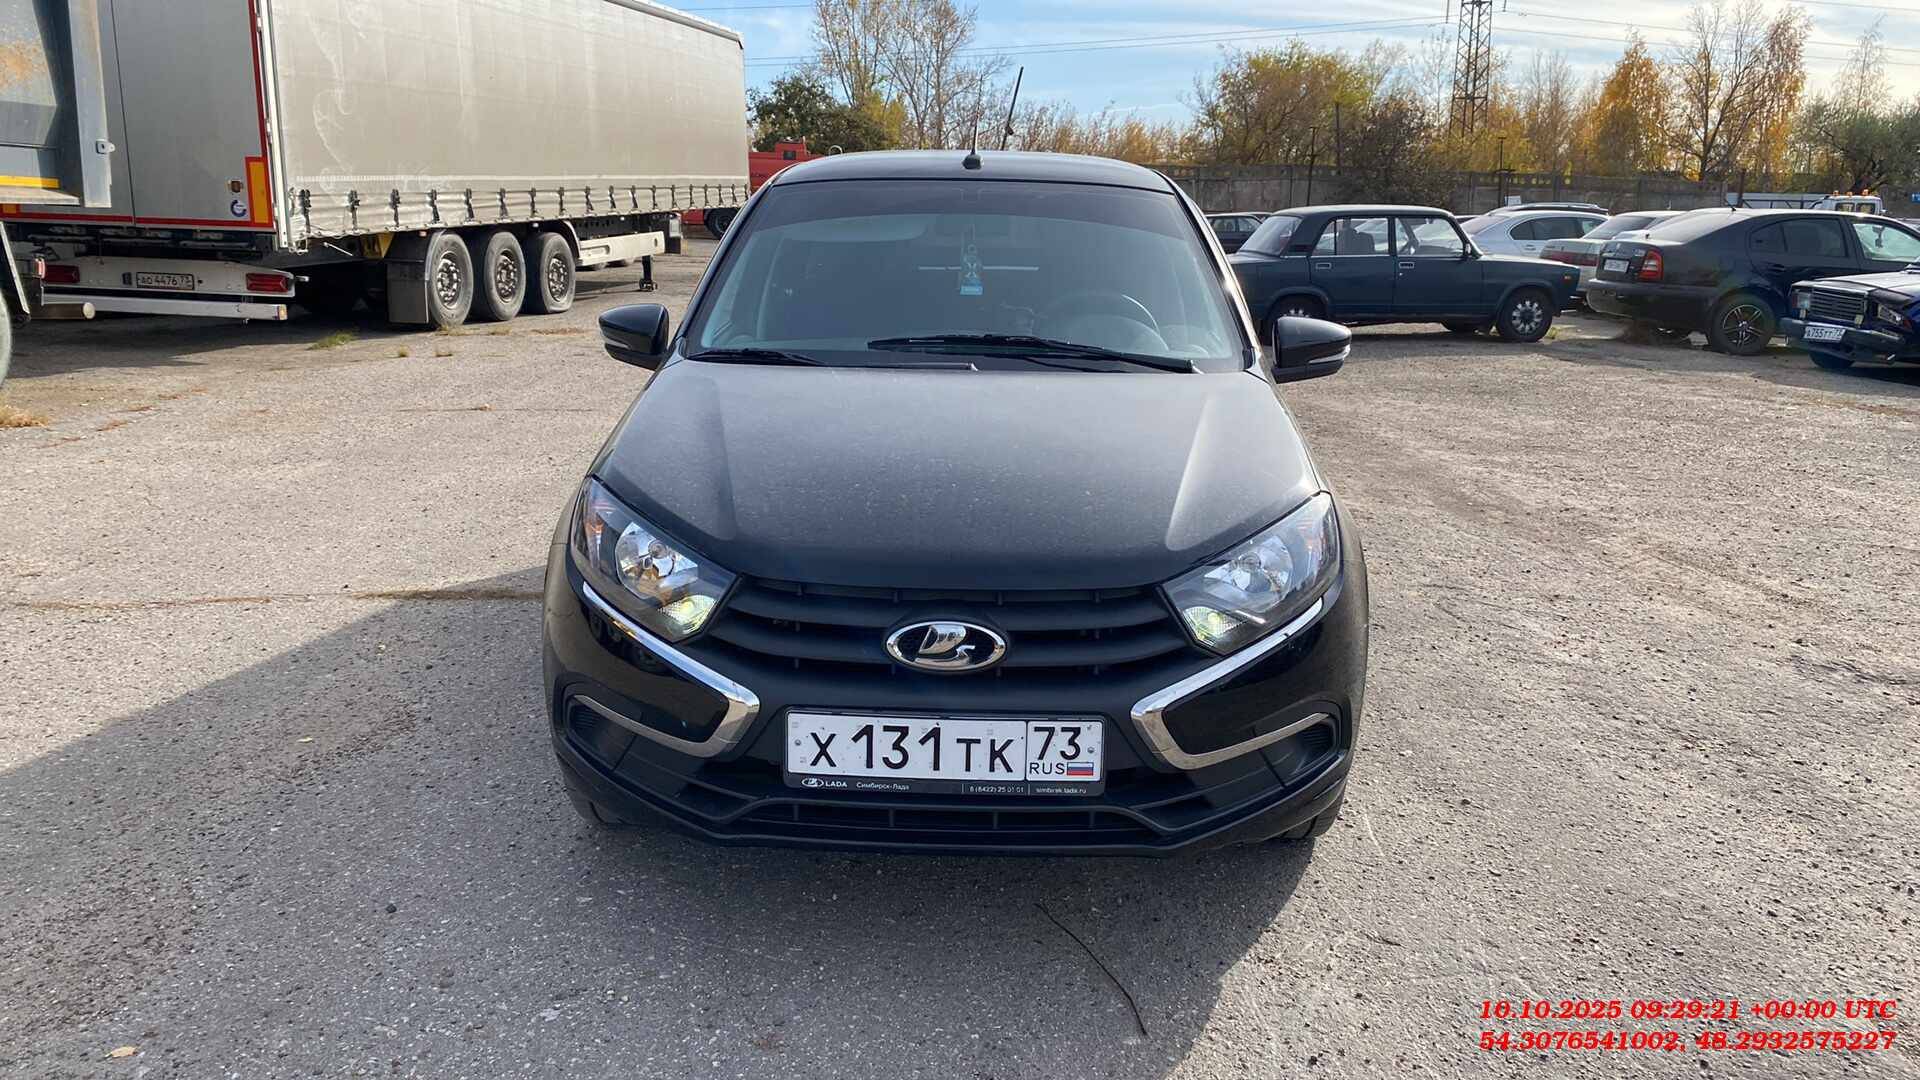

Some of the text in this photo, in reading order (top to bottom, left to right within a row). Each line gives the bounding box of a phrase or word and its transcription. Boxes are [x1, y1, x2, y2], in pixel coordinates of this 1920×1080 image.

[1034, 726, 1082, 760] 73
[1029, 762, 1065, 775] RUS
[825, 779, 848, 788] LADA
[856, 781, 910, 791] Симбирск-Лада
